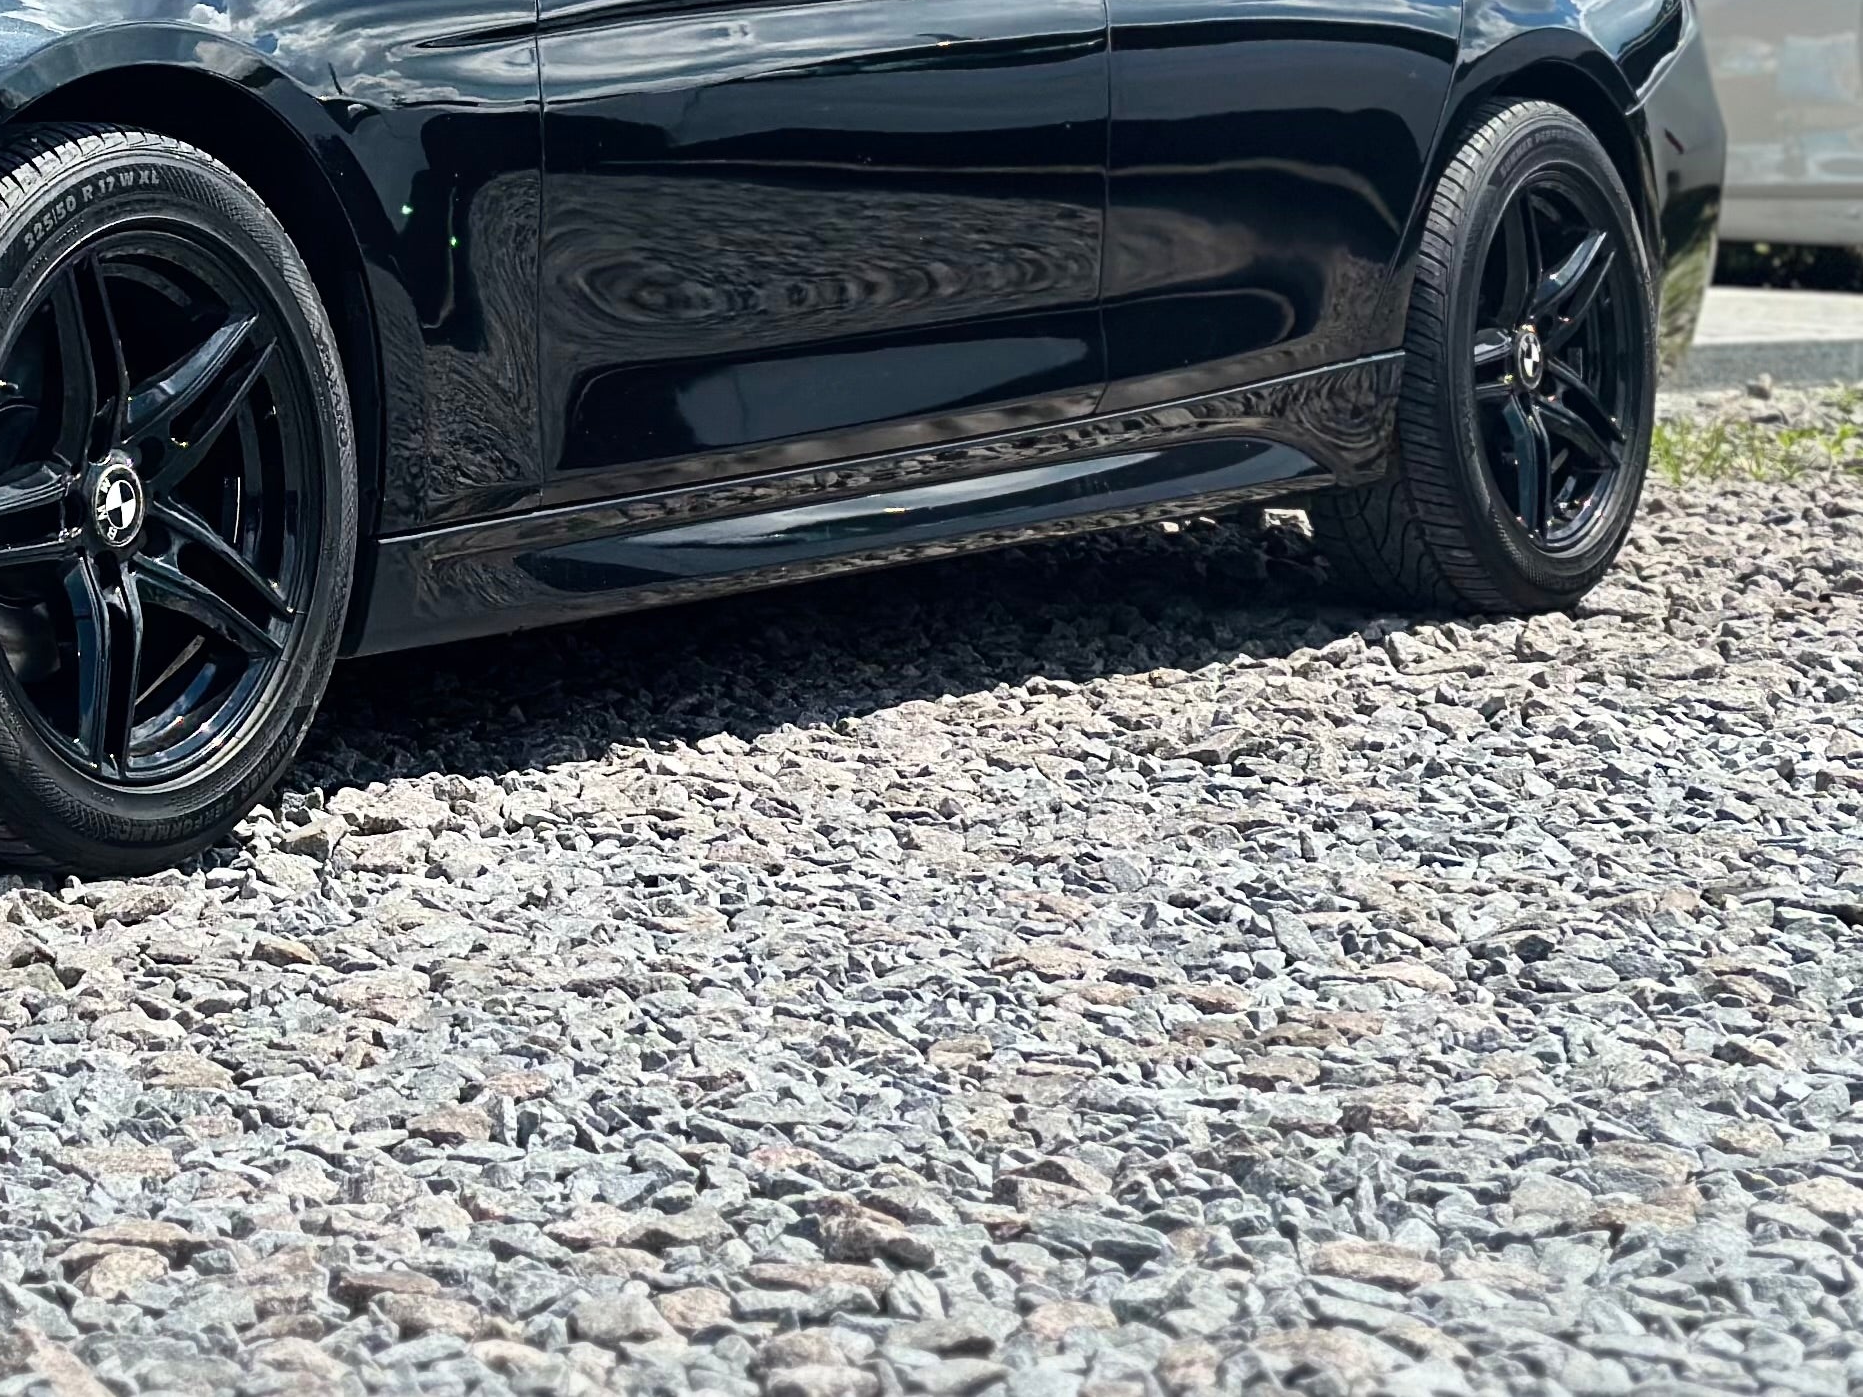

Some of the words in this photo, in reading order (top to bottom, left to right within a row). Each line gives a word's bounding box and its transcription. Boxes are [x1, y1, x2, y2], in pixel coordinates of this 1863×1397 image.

[82, 185, 93, 202] R
[98, 175, 116, 194] 17
[119, 171, 134, 187] W
[139, 168, 160, 184] XL
